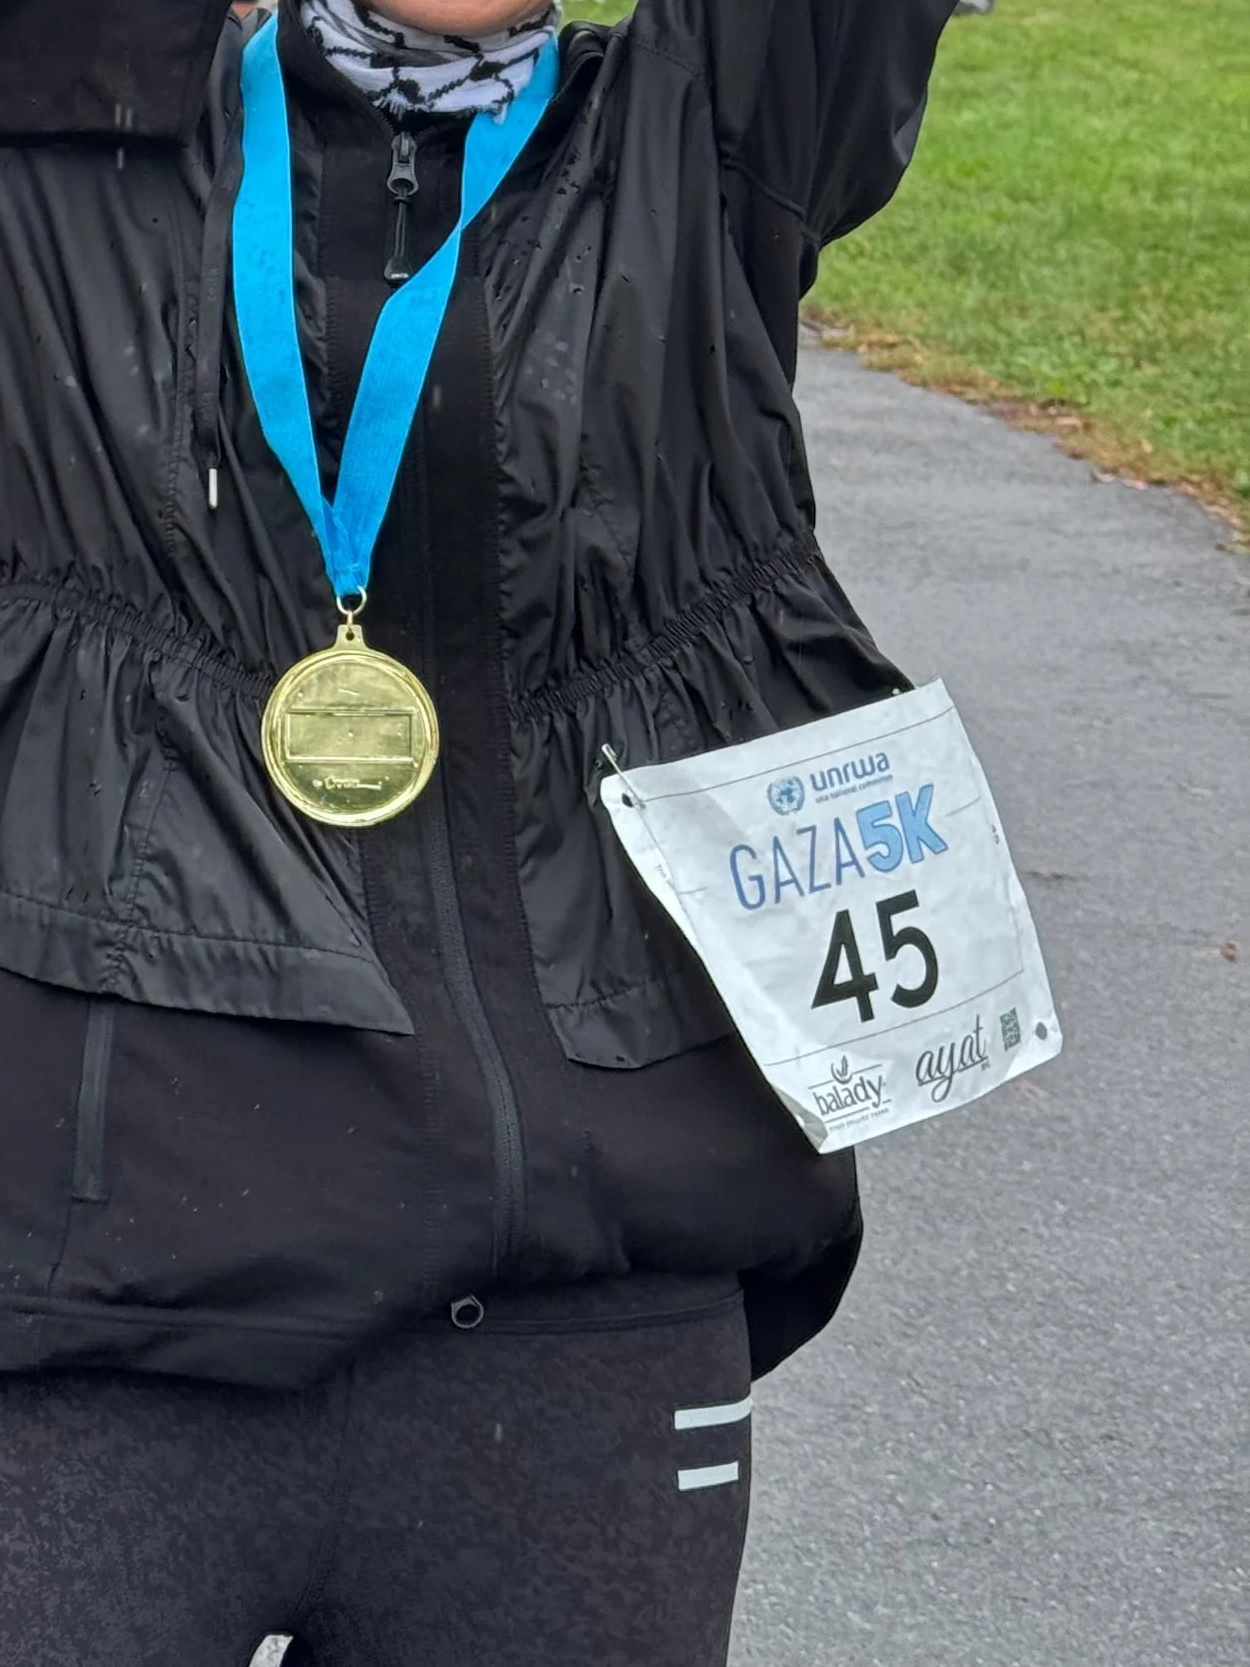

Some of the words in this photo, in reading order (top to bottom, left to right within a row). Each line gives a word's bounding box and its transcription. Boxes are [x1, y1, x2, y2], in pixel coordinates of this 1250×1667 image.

[809, 752, 890, 791] unrwa
[811, 889, 939, 1023] 45
[915, 1014, 988, 1103] ayat
[812, 1075, 883, 1115] balady
